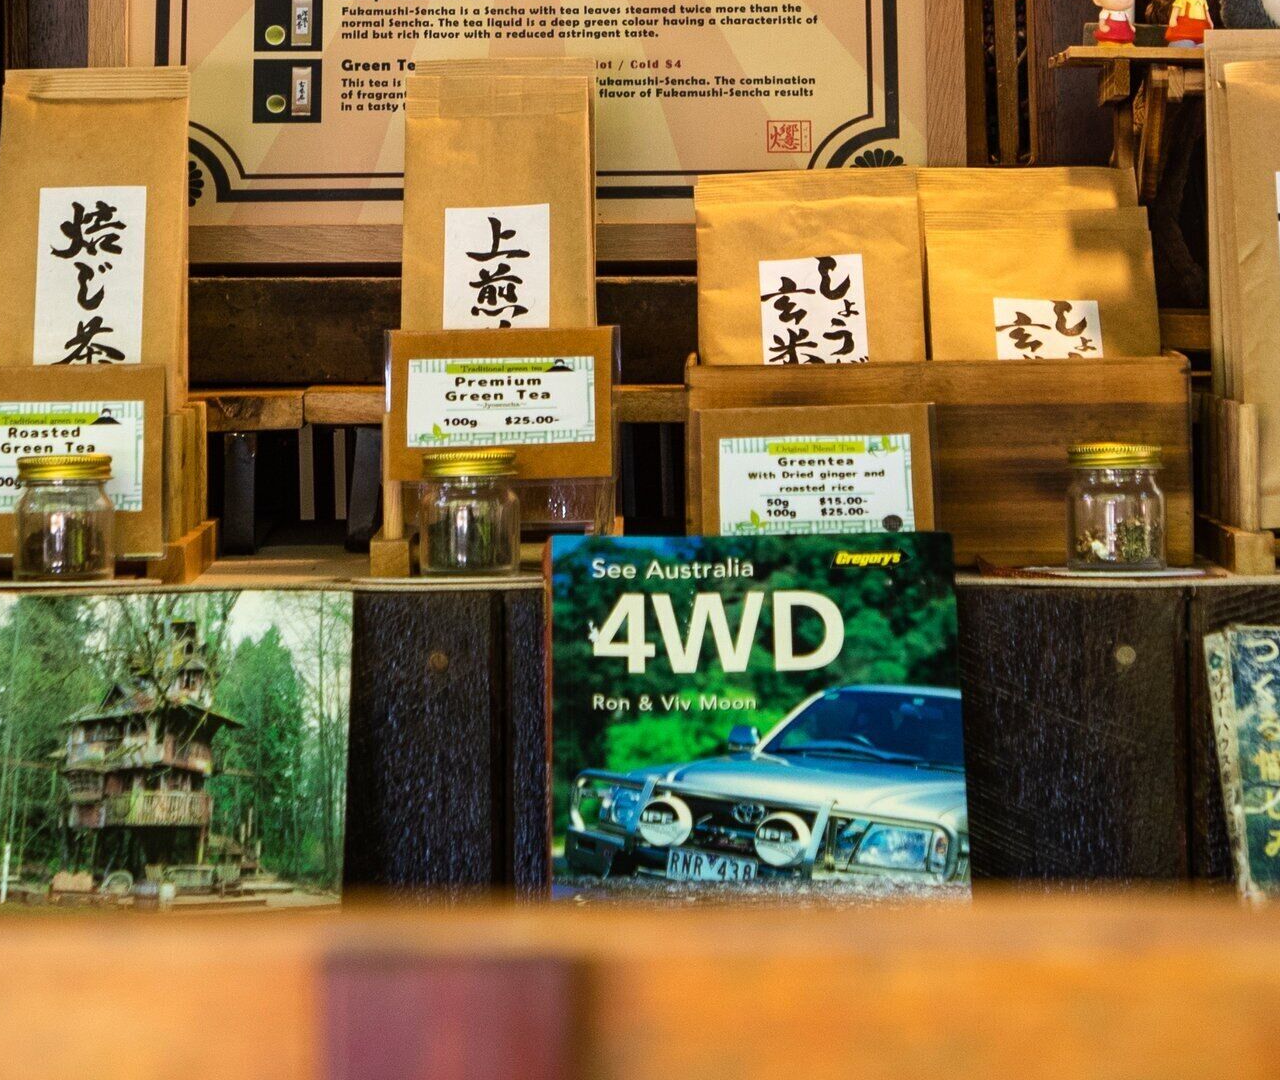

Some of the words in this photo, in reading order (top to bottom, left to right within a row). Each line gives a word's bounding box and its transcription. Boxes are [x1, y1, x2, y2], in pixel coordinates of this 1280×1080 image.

[466, 216, 531, 328] 上煎
[51, 200, 126, 364] 焙じ茶
[815, 256, 869, 364] しょう
[455, 377, 541, 387] Premium
[445, 391, 504, 401] Green
[517, 390, 551, 400] Tea
[443, 418, 478, 428] 100g
[8, 427, 81, 438] Roasted
[1, 443, 53, 454] Green
[65, 442, 96, 453] Tea
[778, 457, 854, 466] Greentea
[748, 472, 776, 480] With
[820, 471, 858, 479] ginger
[767, 499, 789, 508] 50g
[767, 509, 796, 518] 100g
[833, 549, 904, 568] Gregory's
[592, 558, 637, 580] See
[645, 558, 754, 579] Australia
[592, 590, 846, 674] 4WD
[593, 694, 632, 712] Ron
[639, 695, 654, 712] &
[661, 695, 691, 712] Viv
[699, 694, 757, 712] Moon
